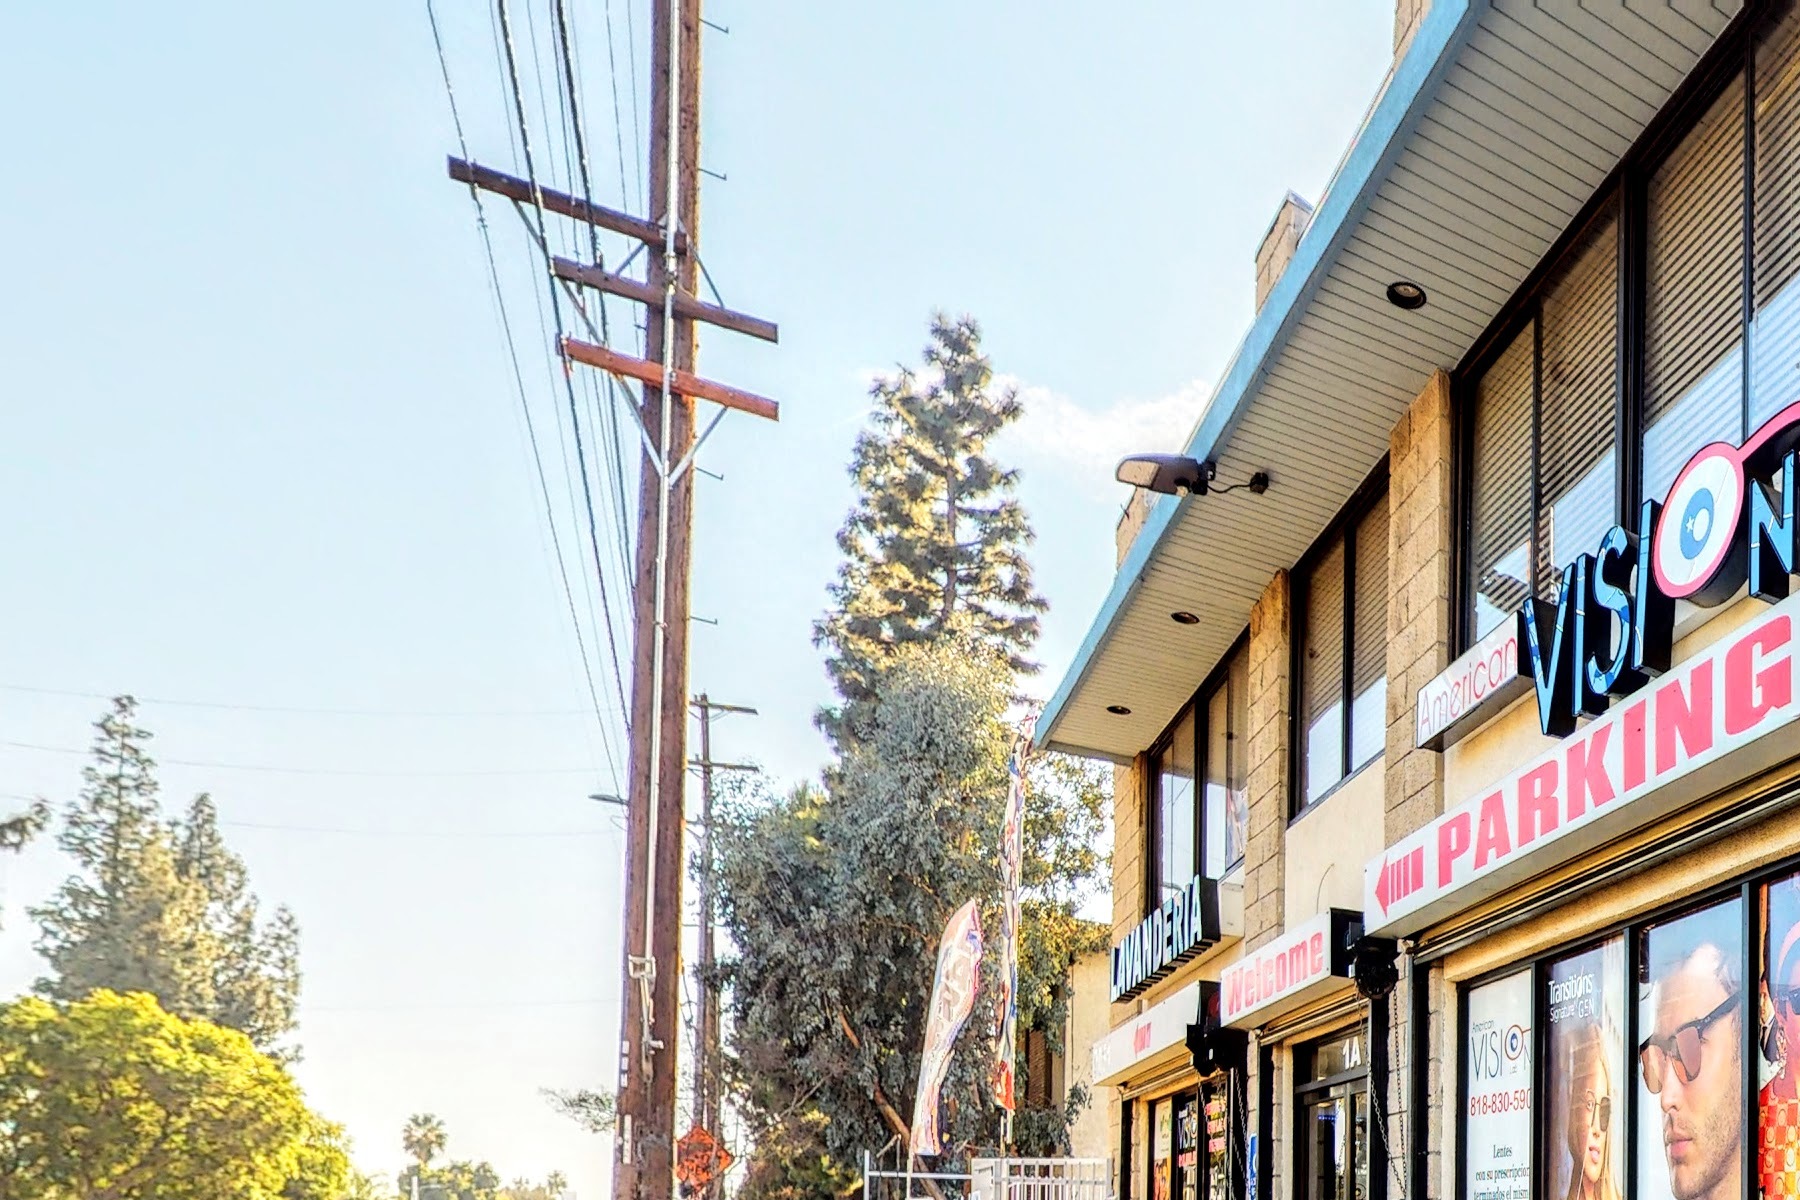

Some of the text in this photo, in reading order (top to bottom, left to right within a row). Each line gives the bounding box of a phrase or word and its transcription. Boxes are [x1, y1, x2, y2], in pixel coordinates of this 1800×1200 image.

[1420, 637, 1517, 737] American
[1438, 614, 1792, 889] PARKING
[1110, 874, 1202, 1003] LAVANDERIA
[1226, 932, 1323, 1016] Welcome
[1548, 967, 1594, 1005] Transitions
[1342, 1036, 1361, 1070] 1A
[1493, 1144, 1512, 1158] Lentes
[1474, 1186, 1505, 1200] terminados
[1506, 1185, 1511, 1200] el
[1476, 1170, 1485, 1181] con
[1487, 1169, 1493, 1180] su
